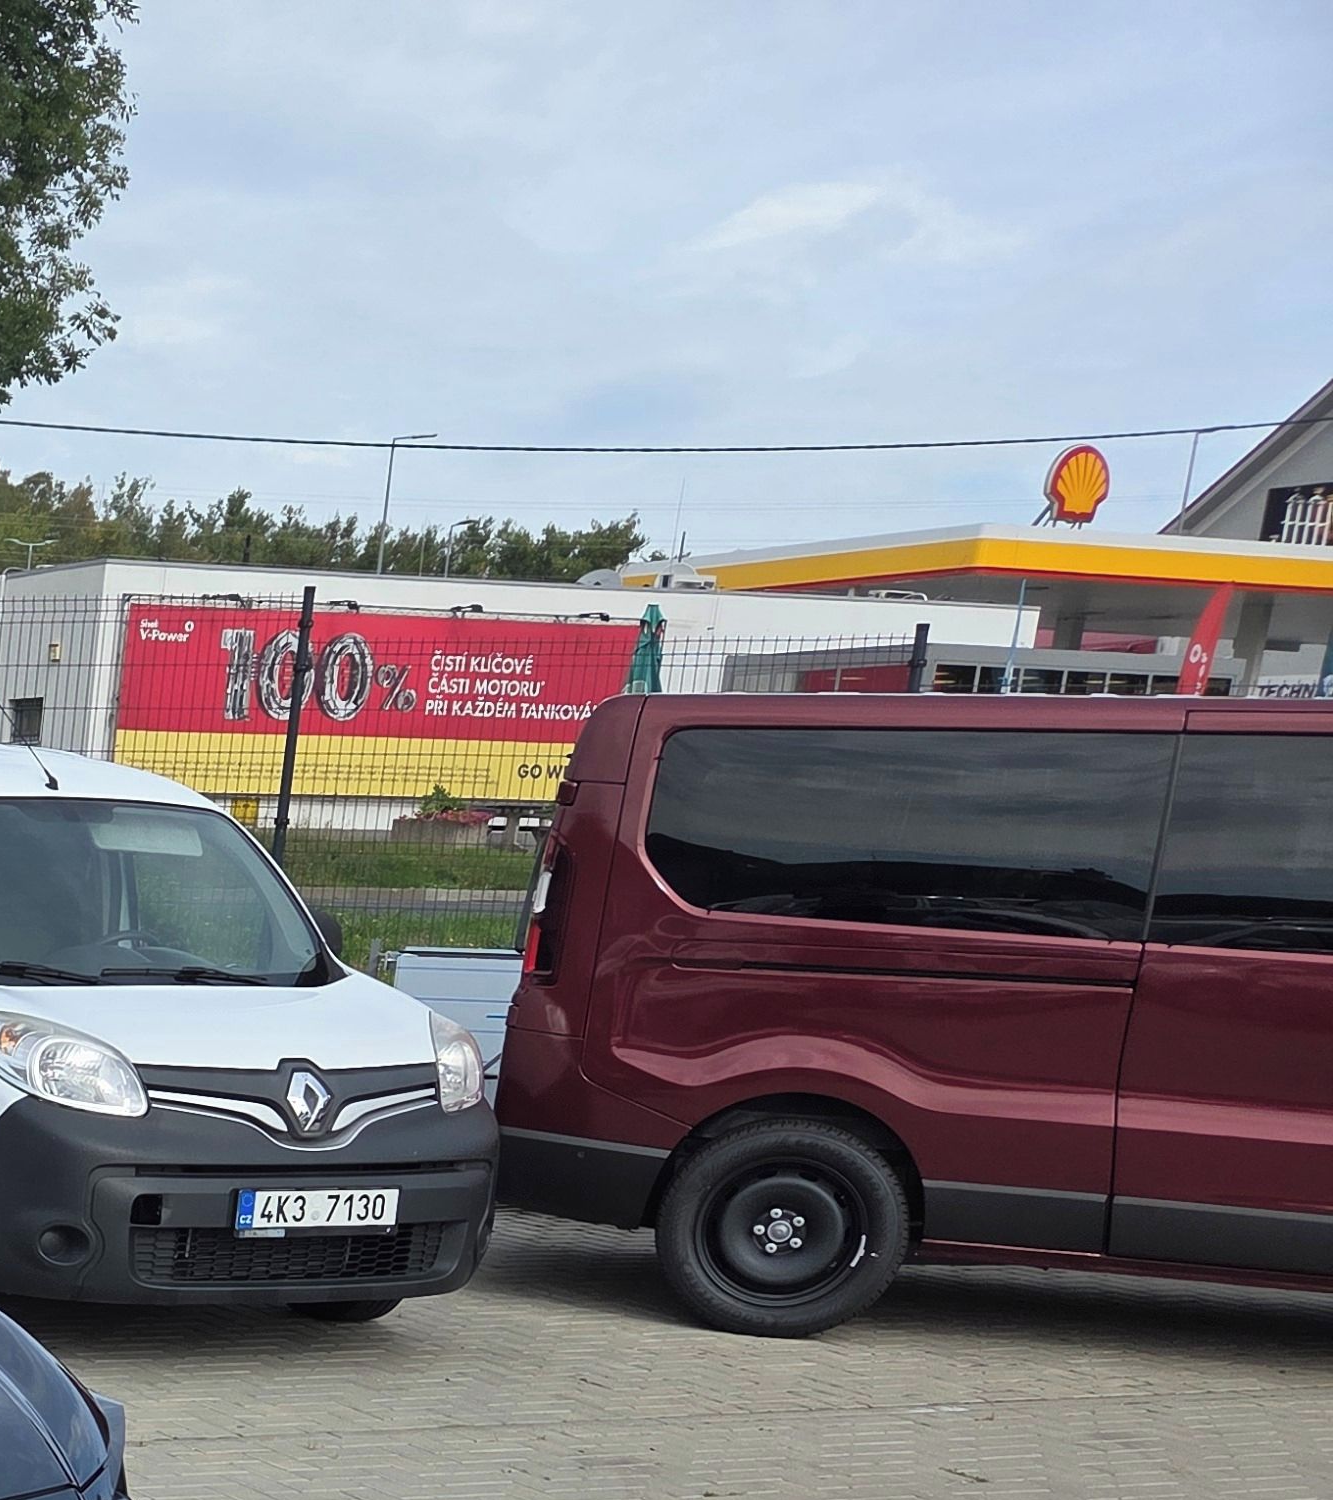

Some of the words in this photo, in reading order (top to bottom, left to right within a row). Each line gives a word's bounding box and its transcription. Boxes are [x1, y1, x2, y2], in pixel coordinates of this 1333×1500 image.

[139, 628, 189, 642] V-Power
[431, 650, 468, 673] ČISTÍ
[470, 651, 534, 675] KLÍČOVÉ
[428, 672, 470, 695] ČÁSTI
[425, 695, 448, 716] PŘI
[451, 697, 517, 719] KAŽDÉM
[517, 764, 542, 779] GO
[240, 1215, 252, 1224] CZ
[260, 1195, 307, 1224] 4K3
[326, 1193, 386, 1222] 7130
